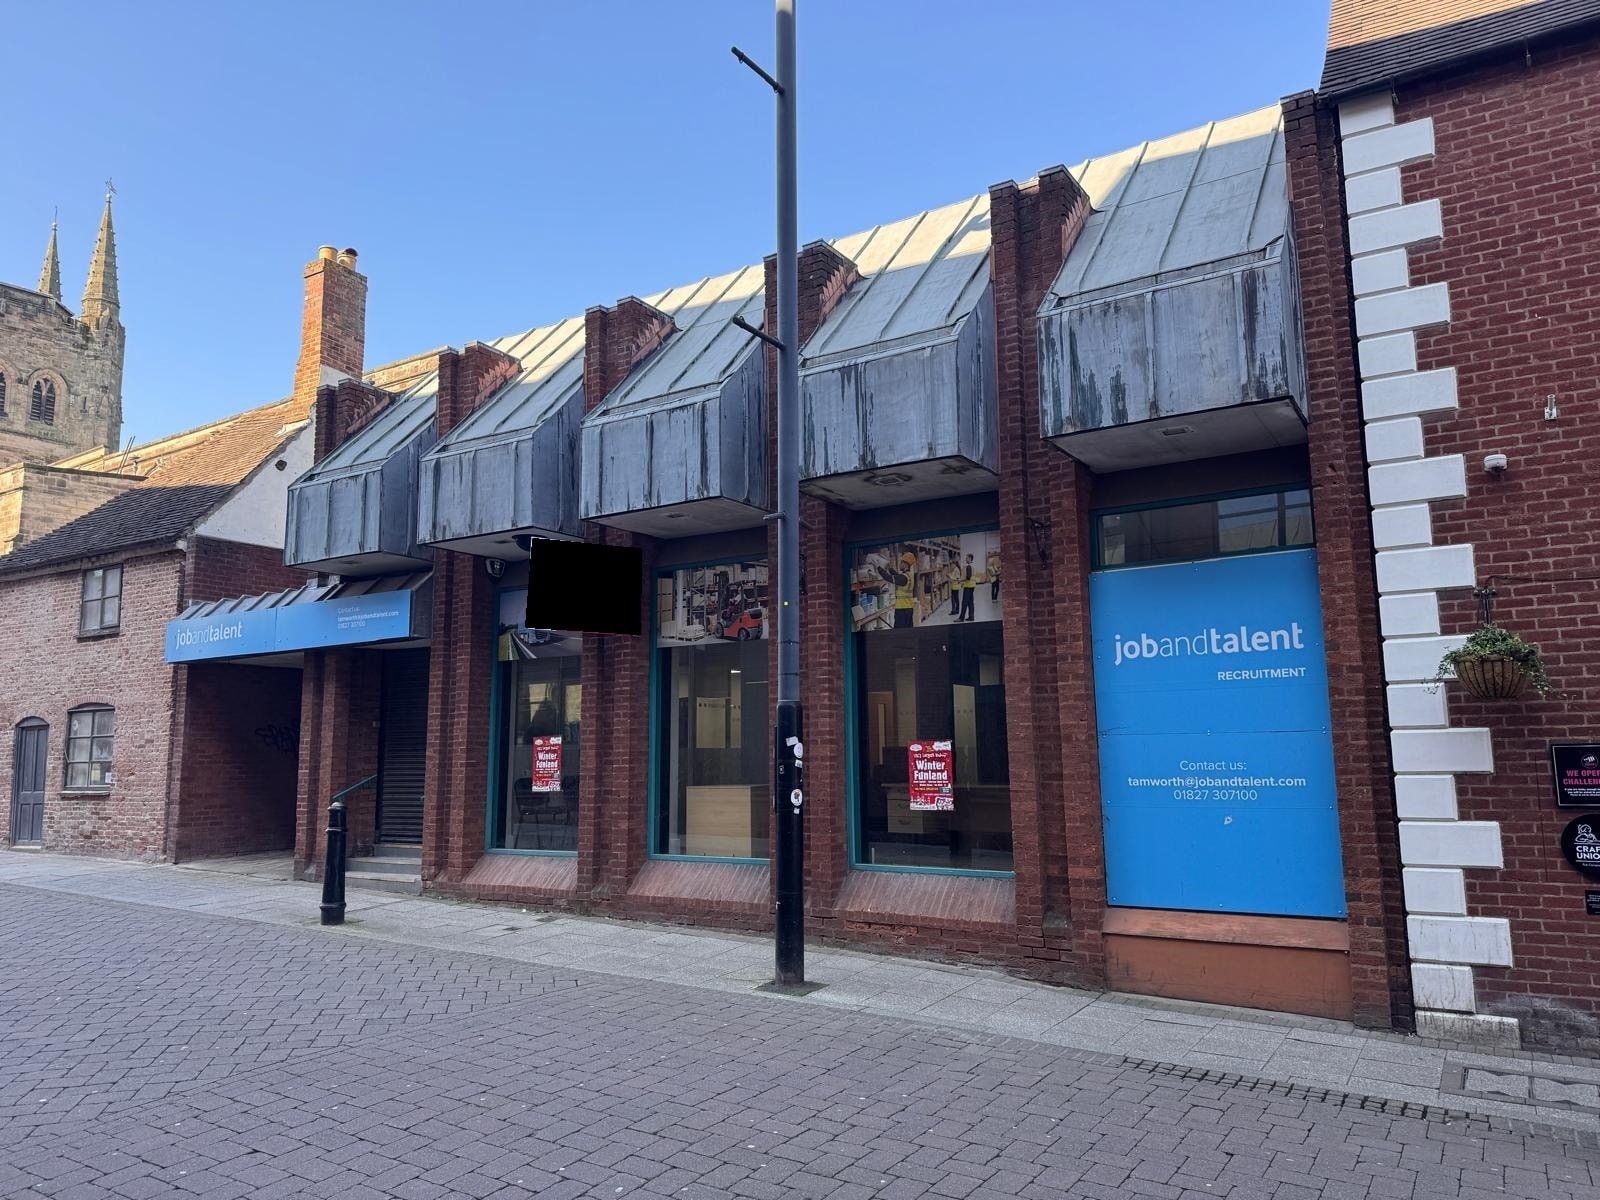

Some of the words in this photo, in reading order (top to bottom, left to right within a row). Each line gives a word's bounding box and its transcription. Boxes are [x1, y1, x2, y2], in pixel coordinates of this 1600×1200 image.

[175, 621, 243, 650] jobandtalent
[1114, 622, 1305, 666] jobandtalent
[1217, 667, 1307, 681] RECRUITMENT
[537, 751, 557, 760] Winter
[536, 760, 558, 768] Funland
[915, 759, 946, 770] Winter
[1179, 760, 1227, 772] Contact
[1229, 760, 1248, 771] us:
[913, 770, 948, 780] Funland
[1566, 769, 1579, 777] WE
[1128, 775, 1307, 788] tamworth@jobandtalent.com
[1173, 789, 1208, 801] 01827
[1212, 789, 1258, 801] 307100
